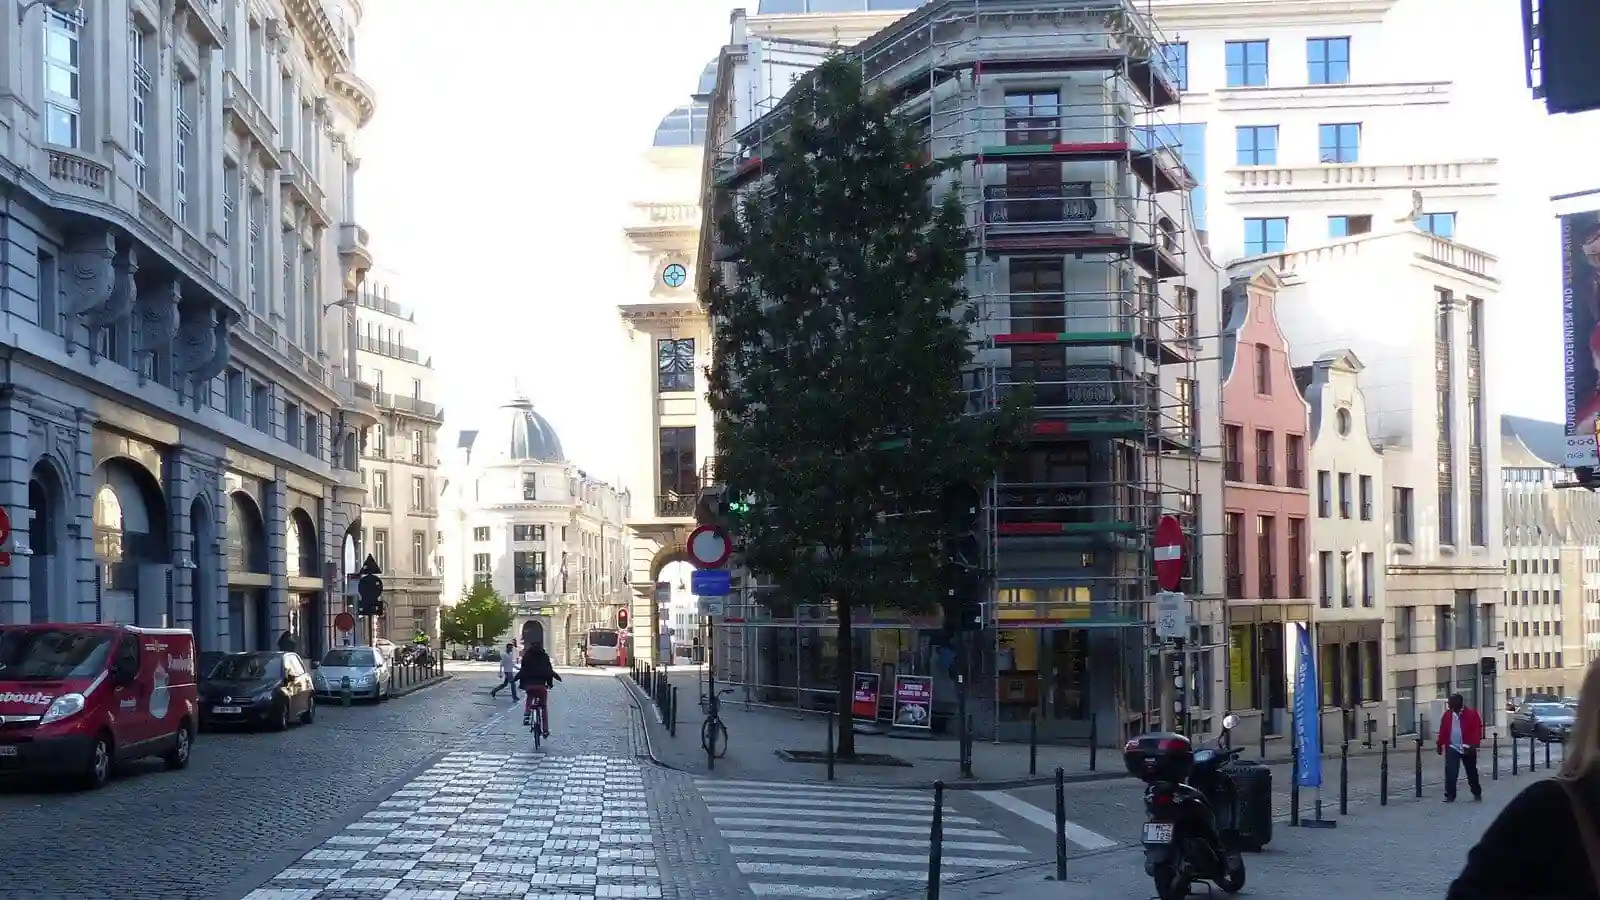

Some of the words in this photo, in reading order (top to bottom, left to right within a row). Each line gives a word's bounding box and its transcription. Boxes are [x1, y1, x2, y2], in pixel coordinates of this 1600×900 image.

[1564, 288, 1573, 309] AND
[1564, 312, 1575, 373] MODERNISM
[1565, 376, 1577, 436] HUNGARIAN
